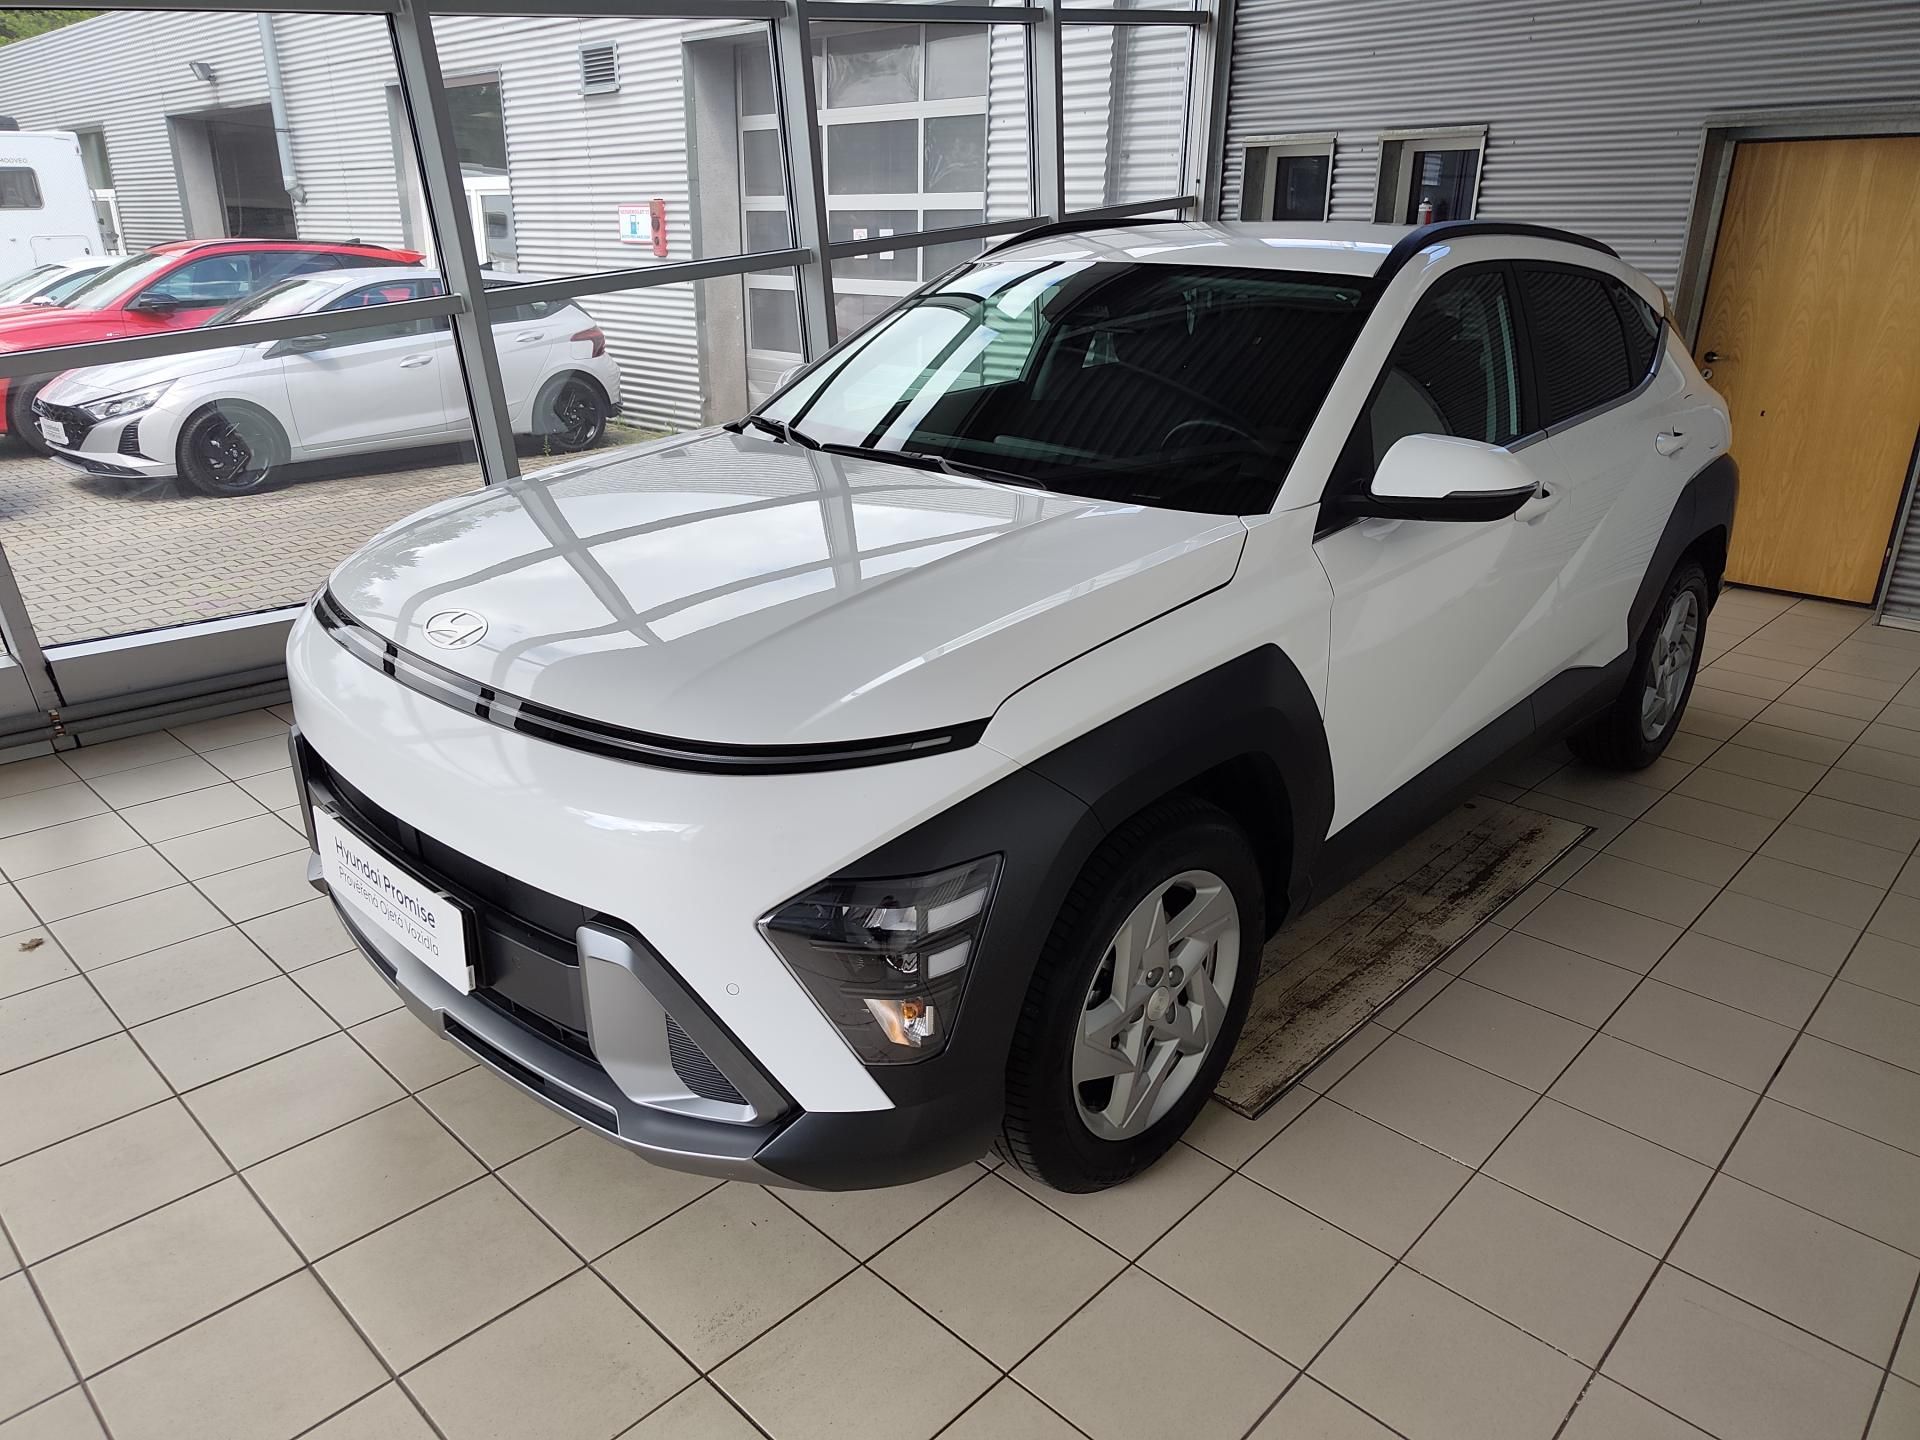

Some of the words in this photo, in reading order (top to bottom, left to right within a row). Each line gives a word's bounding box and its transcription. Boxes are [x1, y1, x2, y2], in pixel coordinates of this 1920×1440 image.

[334, 836, 382, 888] Hyundai
[383, 874, 436, 929] Promise
[405, 919, 439, 956] Vozidla
